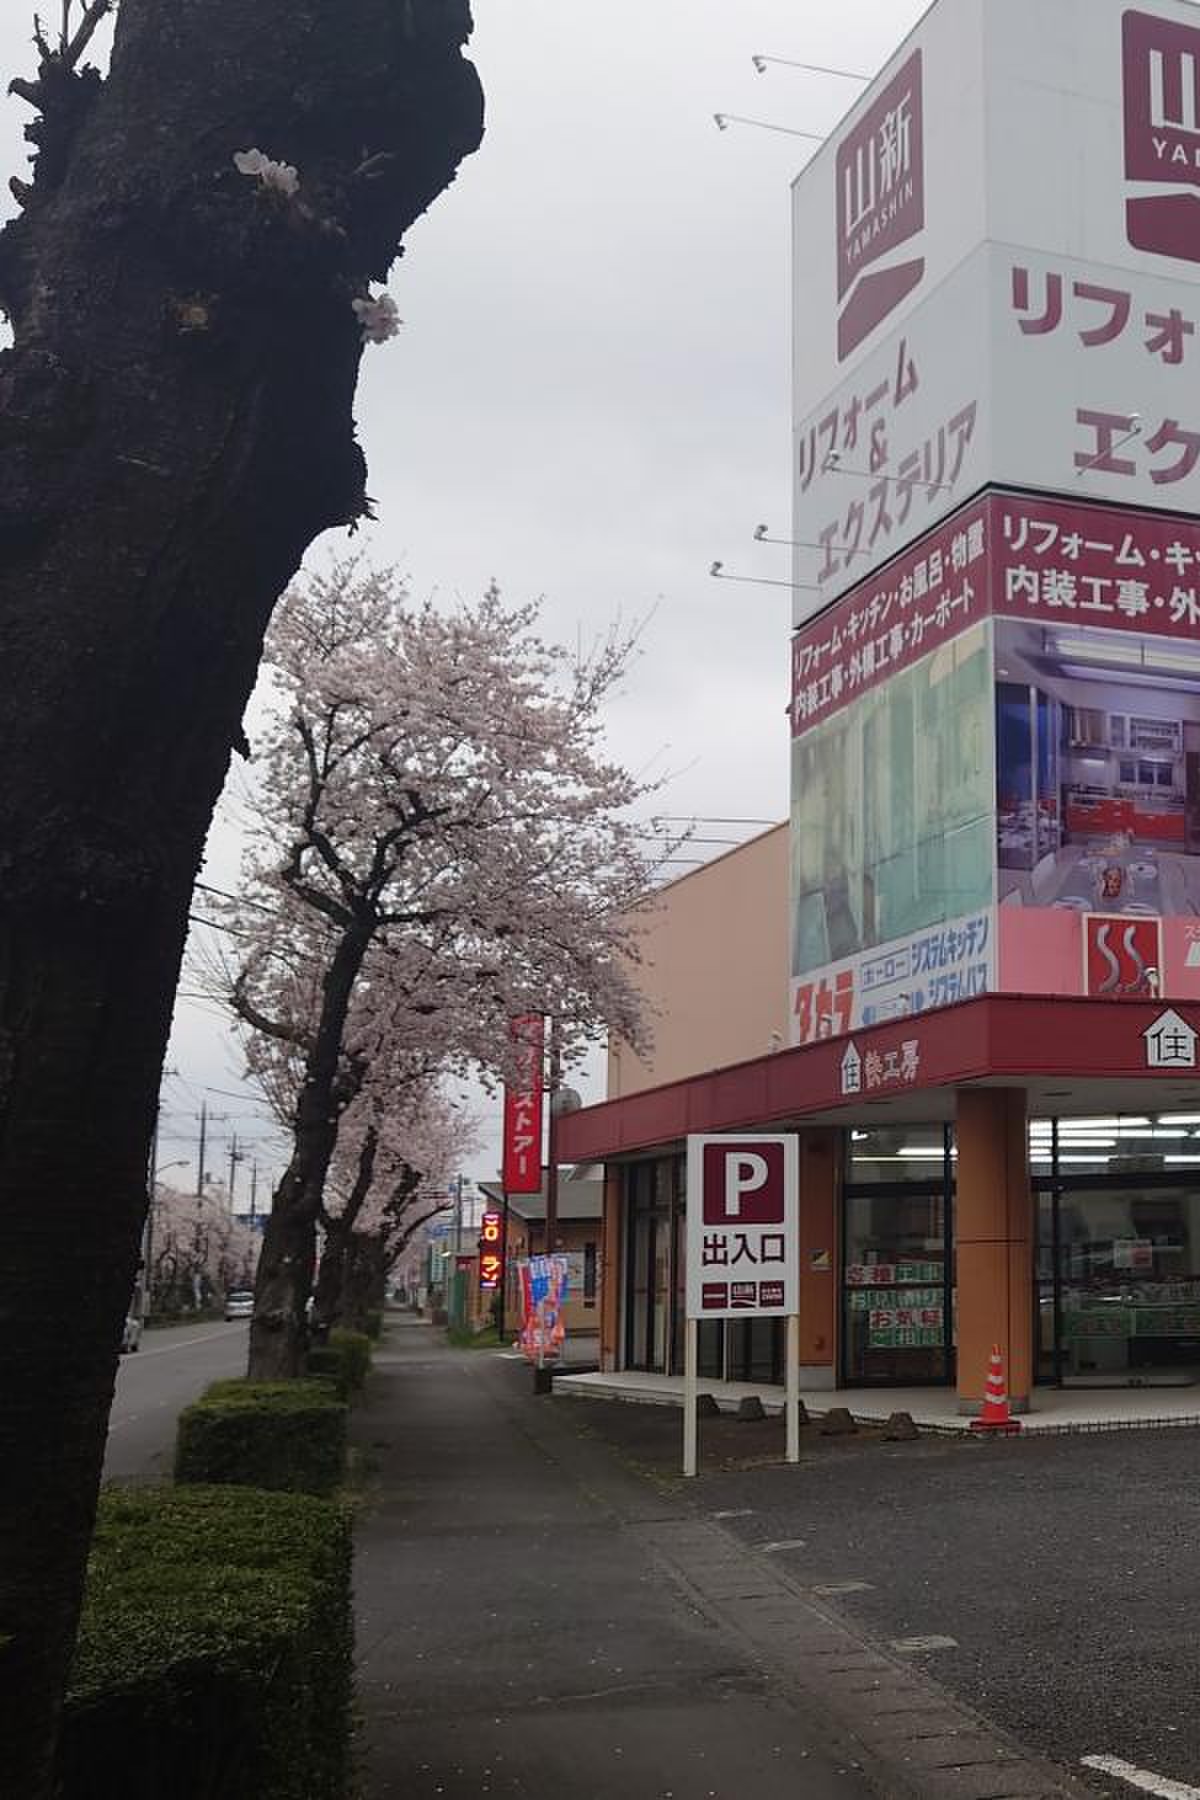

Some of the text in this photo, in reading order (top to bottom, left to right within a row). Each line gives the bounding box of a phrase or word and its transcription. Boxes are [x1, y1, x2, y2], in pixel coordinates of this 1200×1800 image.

[845, 88, 913, 238] 山新
[847, 178, 914, 264] YAMASHIN
[799, 336, 919, 493] リフォーム
[870, 418, 889, 473] &
[818, 399, 977, 583] エクステリア
[725, 1151, 768, 1216] P
[702, 1232, 785, 1267] 出入口
